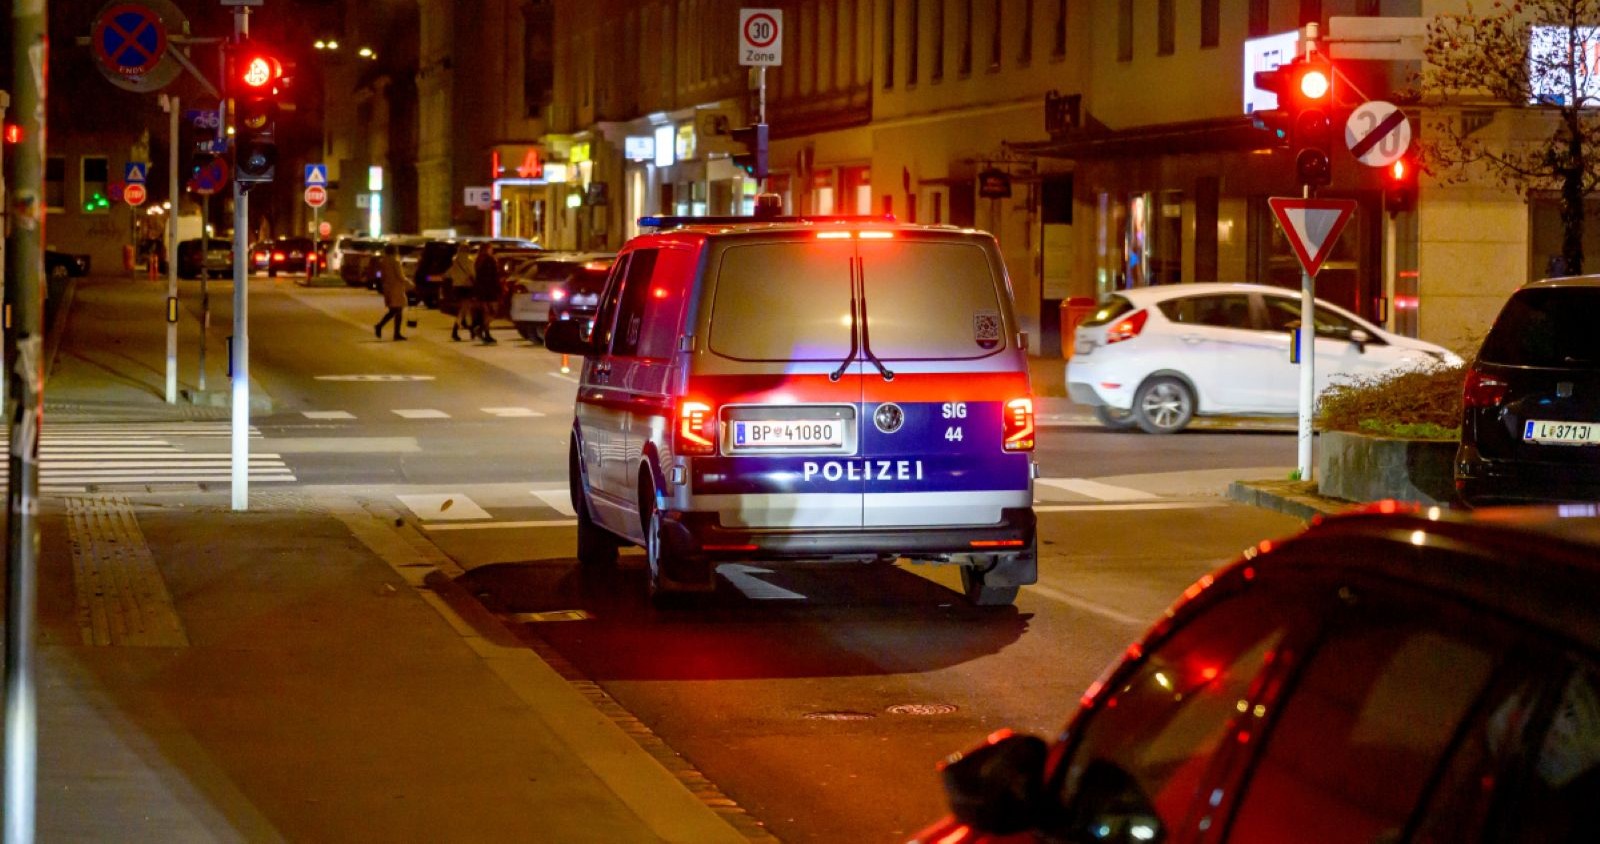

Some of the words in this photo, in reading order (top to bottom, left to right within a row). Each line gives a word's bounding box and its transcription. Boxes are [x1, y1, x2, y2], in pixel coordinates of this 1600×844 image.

[752, 22, 770, 40] 30
[746, 50, 775, 62] Zone
[941, 402, 967, 419] SIG
[751, 424, 772, 441] BP
[784, 424, 833, 441] 41080
[944, 426, 963, 442] 44
[803, 459, 924, 482] POLIZEI
